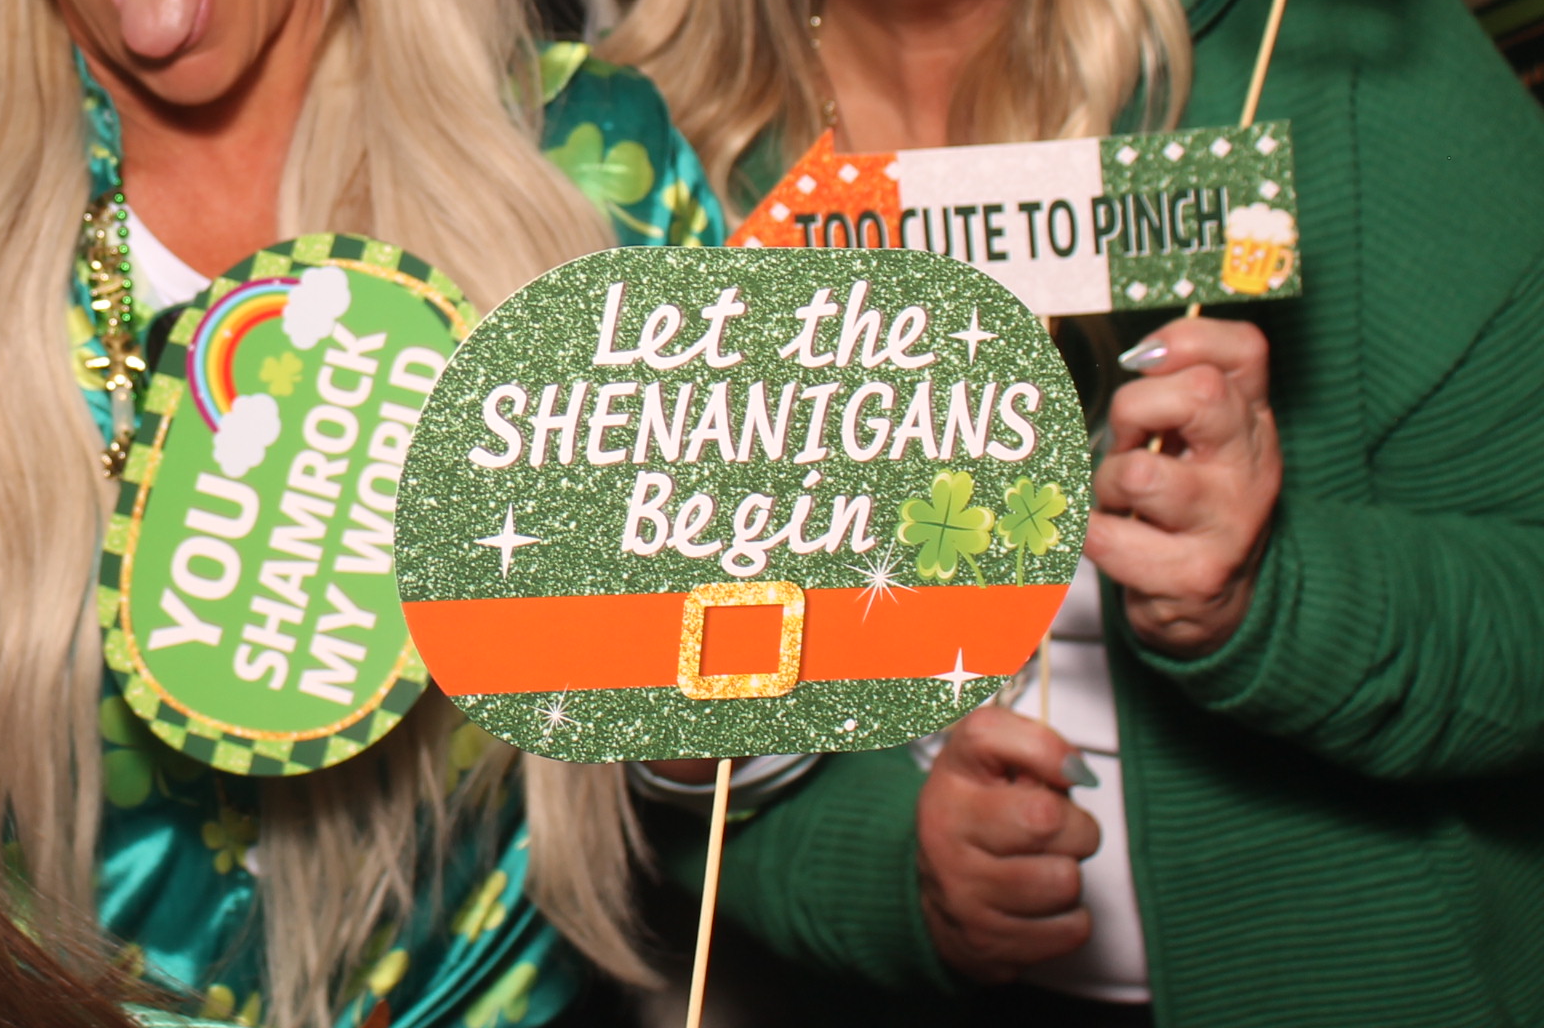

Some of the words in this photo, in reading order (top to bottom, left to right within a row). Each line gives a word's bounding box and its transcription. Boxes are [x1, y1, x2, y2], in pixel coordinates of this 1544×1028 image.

[900, 202, 1009, 262] CUTE
[1017, 198, 1078, 261] TO
[1091, 186, 1229, 258] PINCH
[592, 280, 746, 370] Let
[776, 280, 936, 370] the
[467, 380, 1041, 469] SHENANIGANS
[232, 322, 388, 691] SHAMROCK
[620, 471, 877, 577] Begin
[147, 472, 261, 652] YOU
[298, 583, 378, 707] MY
